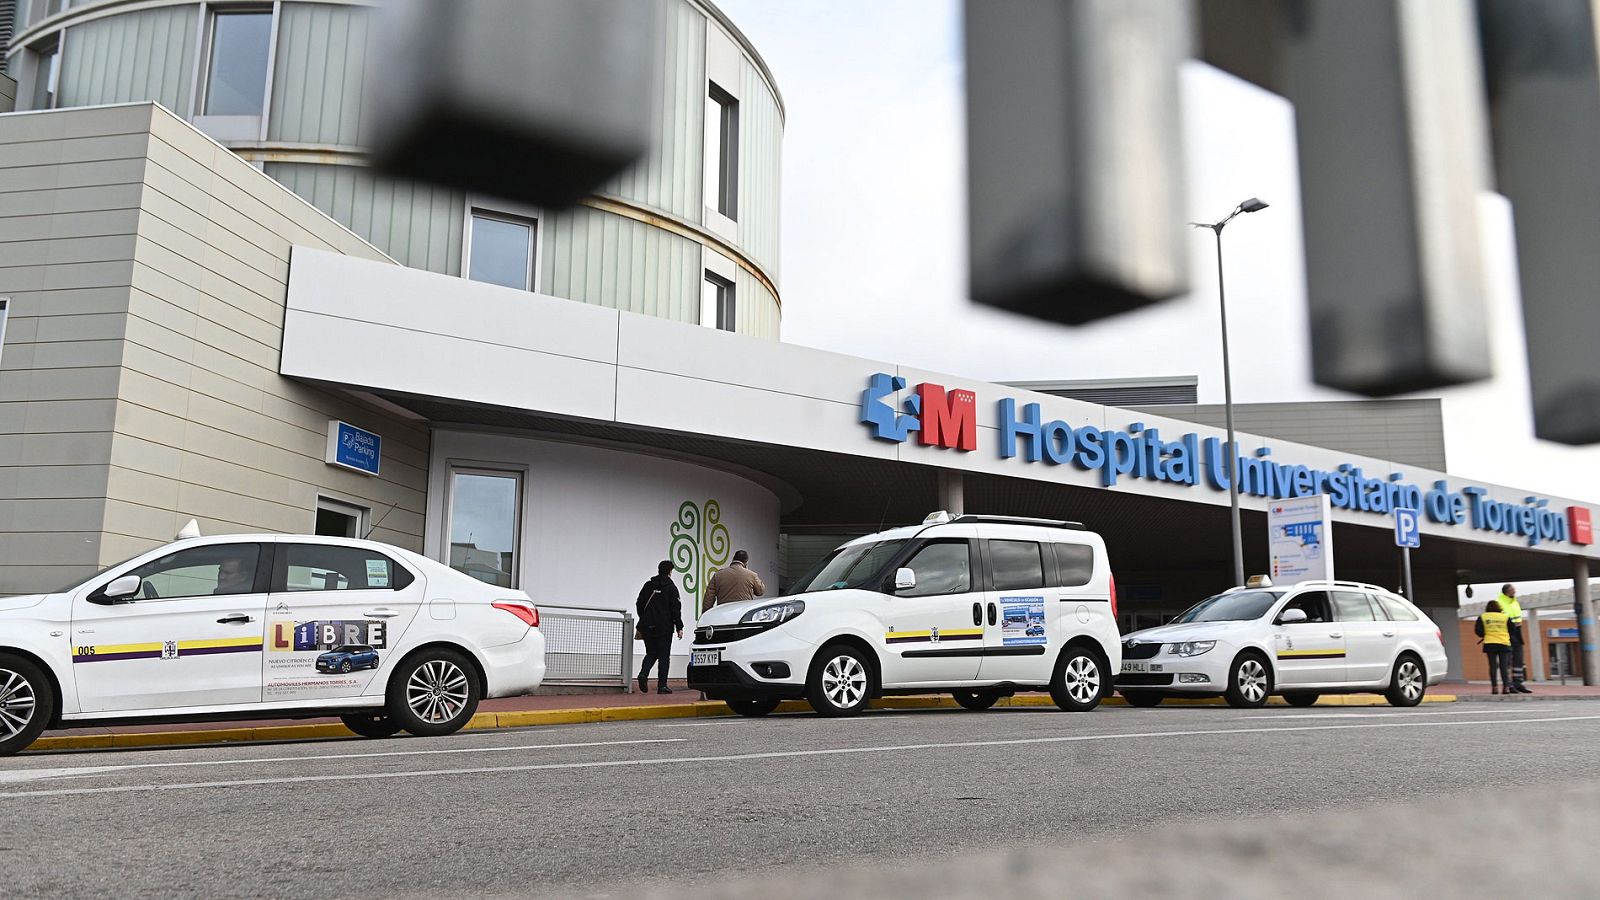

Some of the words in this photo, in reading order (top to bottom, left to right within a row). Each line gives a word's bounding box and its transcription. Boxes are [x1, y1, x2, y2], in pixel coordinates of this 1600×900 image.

[917, 382, 977, 451] M
[355, 431, 374, 446] Bajada
[354, 442, 375, 459] Parking
[998, 397, 1200, 487] Hospital
[1204, 437, 1424, 517] Universitario
[1425, 480, 1465, 525] de
[1462, 486, 1568, 546] Torrejón
[1400, 512, 1415, 542] P
[78, 645, 96, 656] 005
[707, 653, 718, 664] KYP
[1133, 662, 1145, 671] HLL
